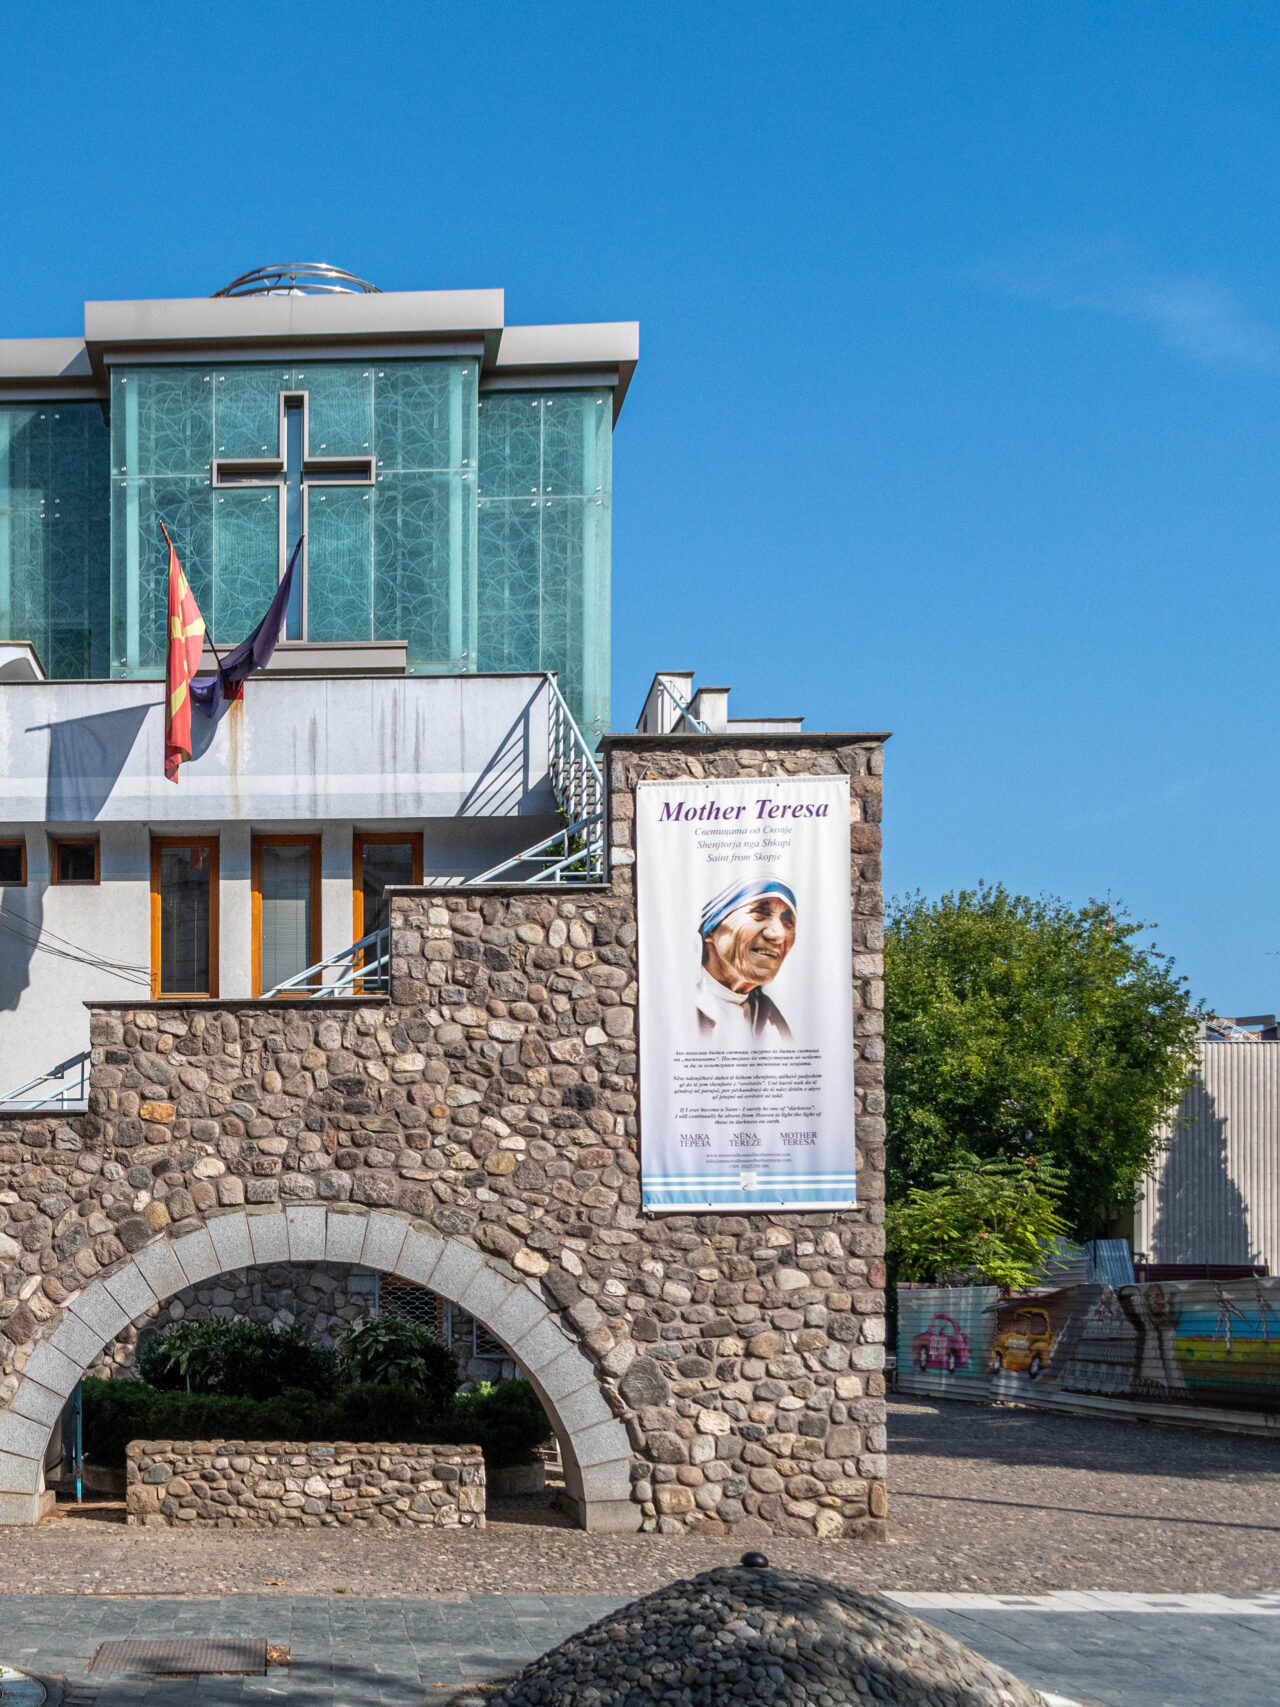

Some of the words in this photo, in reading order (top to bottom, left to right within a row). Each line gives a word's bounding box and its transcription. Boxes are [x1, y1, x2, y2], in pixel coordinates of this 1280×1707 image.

[658, 801, 746, 821] Mother
[756, 800, 829, 819] Teresa
[695, 827, 747, 836] Светицата
[763, 826, 792, 836] Скопје
[744, 841, 759, 849] nga
[762, 839, 792, 849] Shkupi
[707, 854, 728, 862] Saint
[730, 853, 751, 863] from
[753, 852, 782, 862] Skopje
[783, 1138, 816, 1146] TERESA
